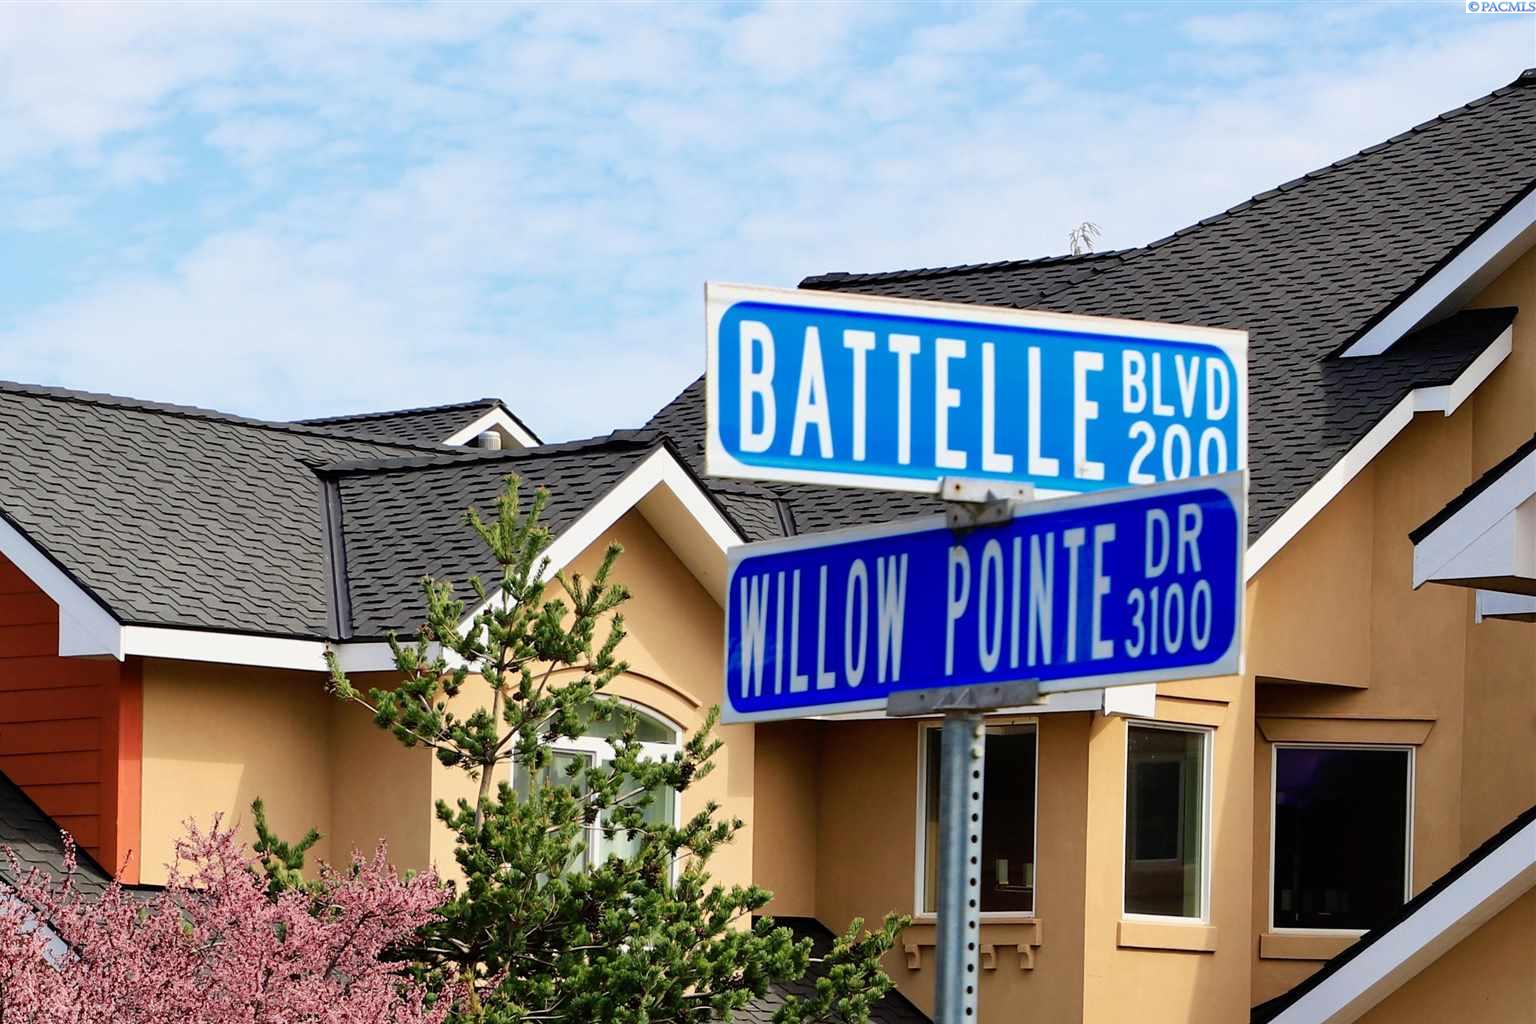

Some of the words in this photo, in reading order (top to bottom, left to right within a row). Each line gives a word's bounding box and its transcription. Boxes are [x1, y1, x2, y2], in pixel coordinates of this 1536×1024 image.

[739, 320, 1105, 480] BATTELLE
[1122, 350, 1230, 420] BLVD
[1127, 421, 1227, 484] 200
[740, 553, 908, 698] WILLOW
[945, 522, 1117, 676] POINTE
[1145, 503, 1203, 578] DR
[1125, 578, 1212, 658] 3100
